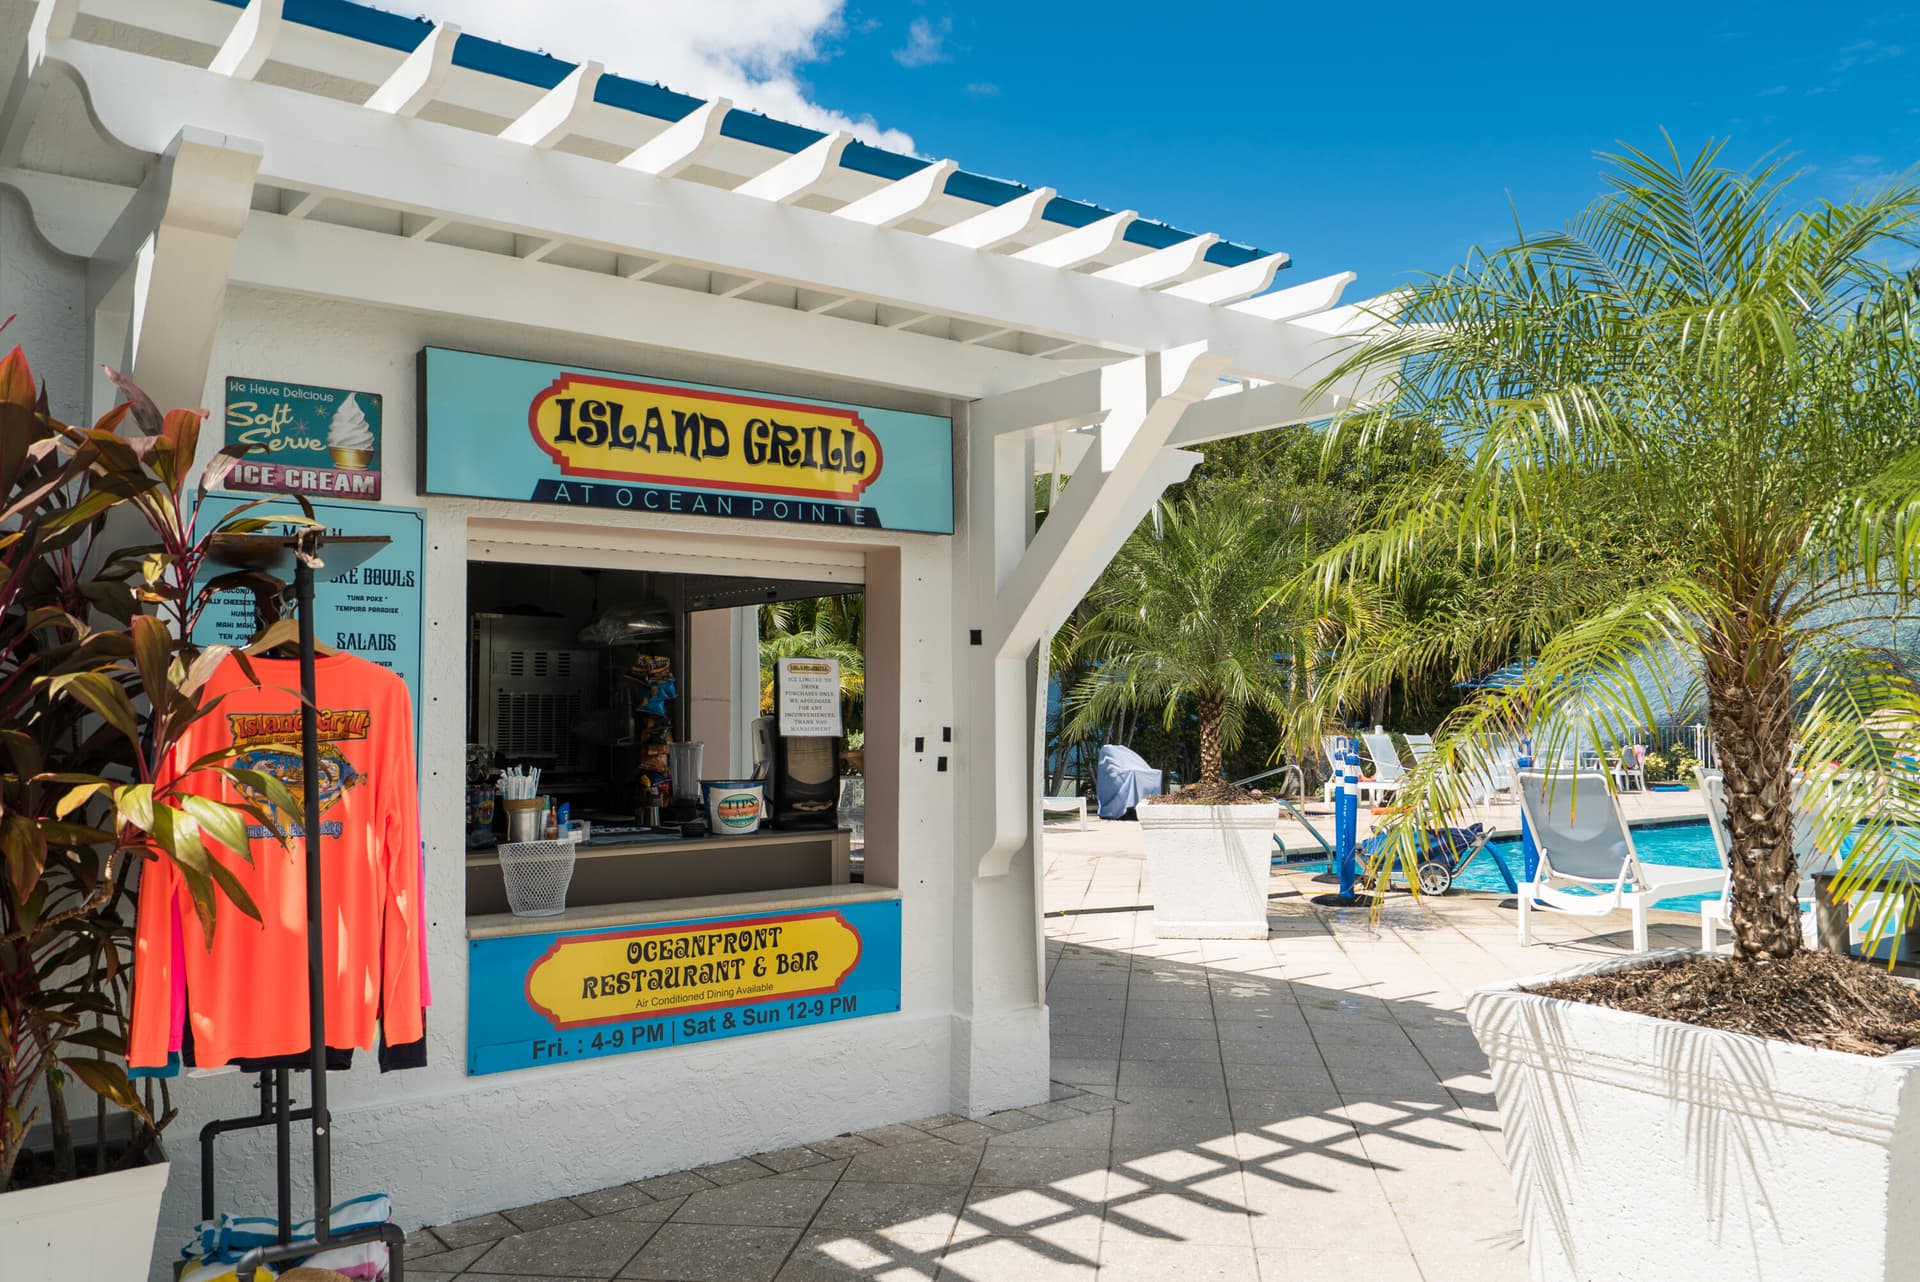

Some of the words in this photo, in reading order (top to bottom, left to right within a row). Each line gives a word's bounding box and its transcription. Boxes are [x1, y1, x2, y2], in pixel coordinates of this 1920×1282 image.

[230, 381, 246, 392] We
[250, 384, 280, 396] Have
[283, 387, 334, 402] Delicious
[226, 401, 294, 434] Soft
[239, 428, 327, 454] Serve
[554, 398, 729, 462] ISLAND
[743, 417, 867, 475] GRILL
[234, 464, 274, 486] ICE
[285, 469, 375, 494] CREAM
[554, 482, 593, 505] AT
[616, 487, 733, 515] OCEAN
[752, 500, 867, 526] POINTE
[363, 568, 414, 588] BOWLS
[337, 632, 396, 651] SALADS
[316, 709, 368, 736] Grill
[727, 798, 755, 809] TIPS
[626, 926, 783, 965] OCEANFRONT
[581, 958, 745, 1000] RESTAURANT
[752, 956, 767, 977] &
[776, 951, 819, 975] BAR
[635, 998, 649, 1009] Air
[651, 992, 705, 1007] Conditioned
[707, 988, 735, 1000] Dining
[736, 983, 774, 995] Available
[532, 1037, 569, 1061] Fri.
[591, 1030, 624, 1051] 4-9
[631, 1022, 665, 1046] PM
[683, 1016, 717, 1037] Sat
[722, 1012, 737, 1031] &
[742, 1007, 780, 1028] Sun
[786, 1000, 824, 1021] 12-9
[829, 995, 858, 1016] PM
